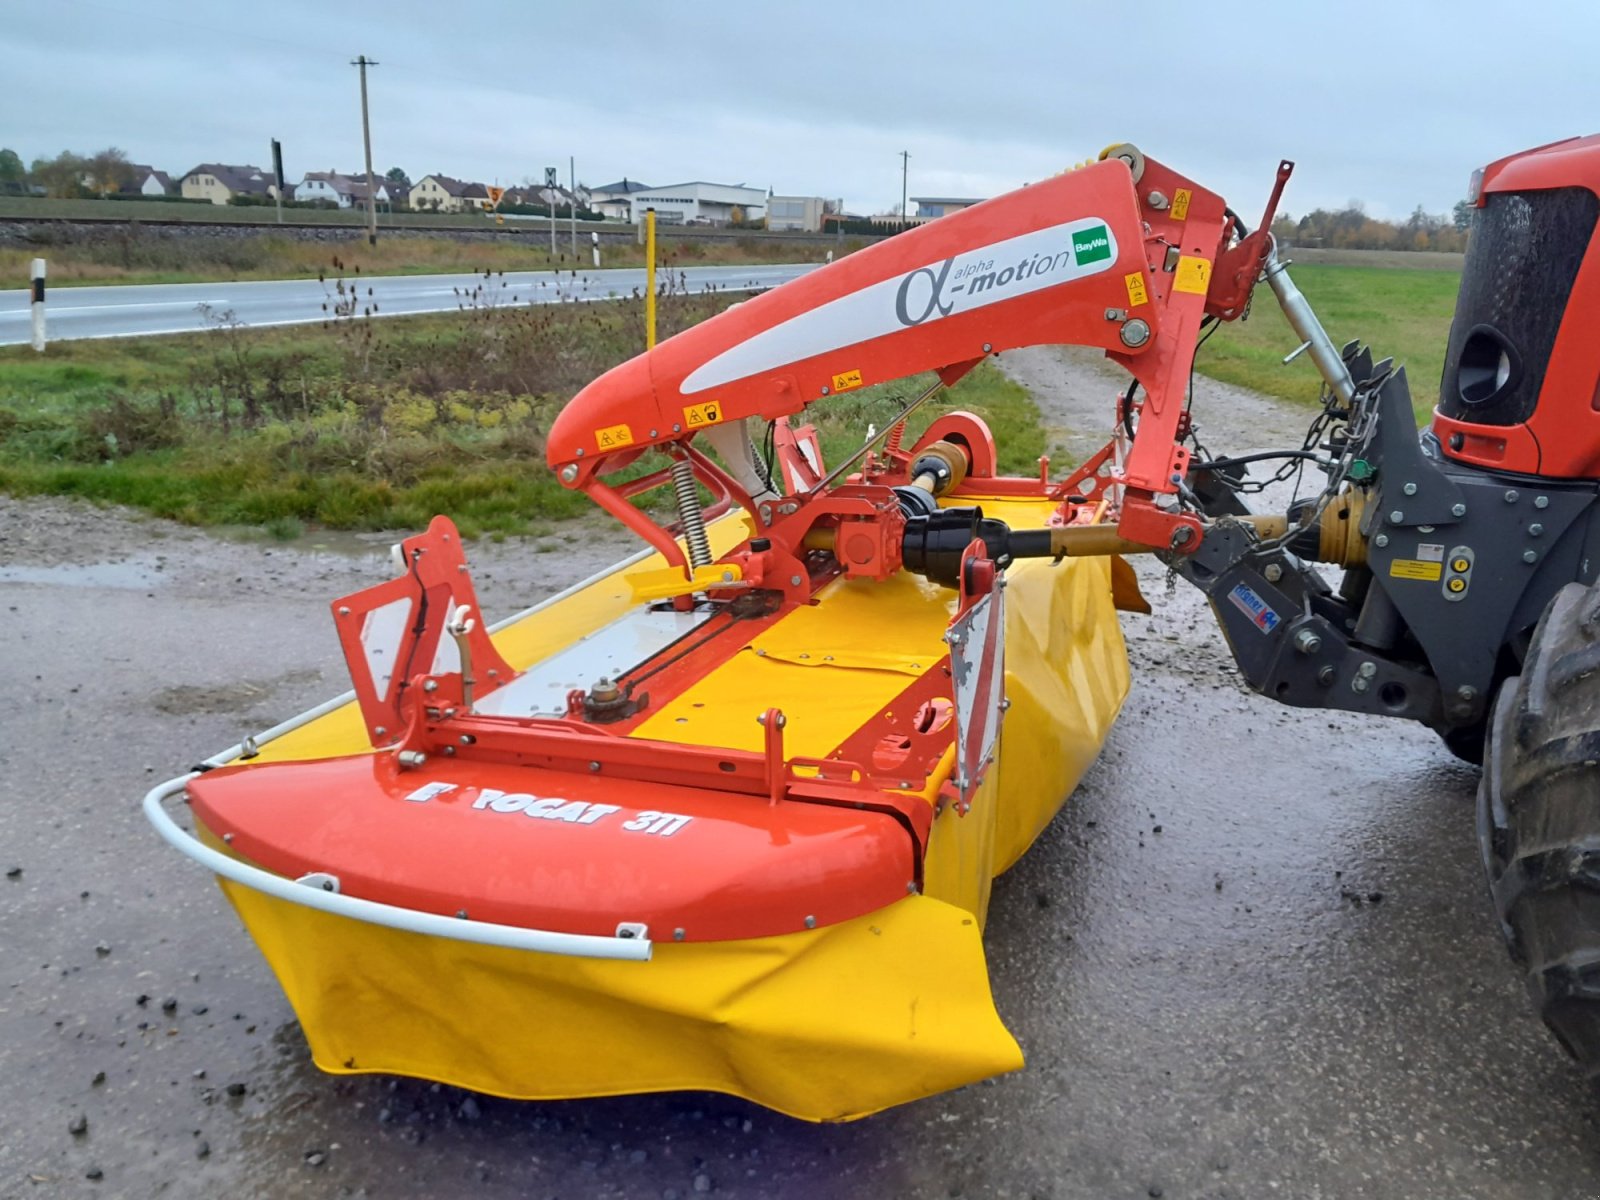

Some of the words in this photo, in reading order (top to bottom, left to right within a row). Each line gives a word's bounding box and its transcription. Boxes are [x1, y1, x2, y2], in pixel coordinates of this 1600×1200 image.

[1075, 237, 1108, 252] BayWa
[954, 259, 994, 280] alpha
[622, 810, 694, 836] 311
